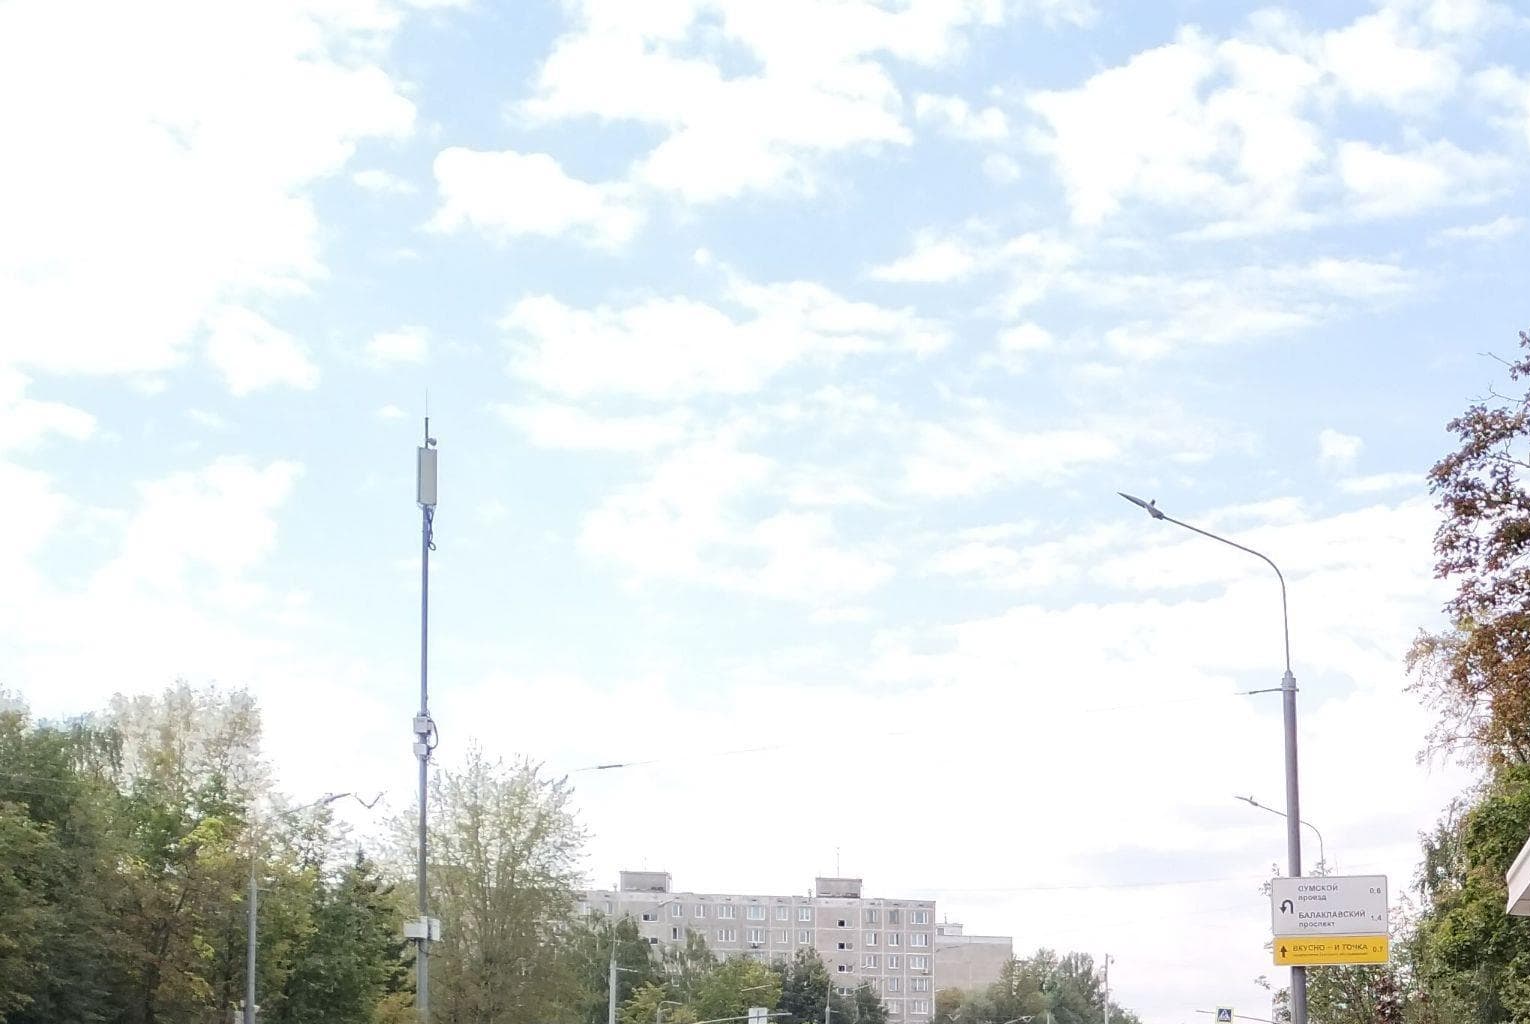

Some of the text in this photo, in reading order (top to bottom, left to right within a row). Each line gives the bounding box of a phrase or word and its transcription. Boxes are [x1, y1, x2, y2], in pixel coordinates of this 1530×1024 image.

[1298, 909, 1366, 919] БАЛАКЛАВСКИЙ
[1298, 921, 1335, 929] проспект
[1292, 944, 1326, 952] ВКУСНО
[1341, 943, 1369, 951] ТОЧКА
